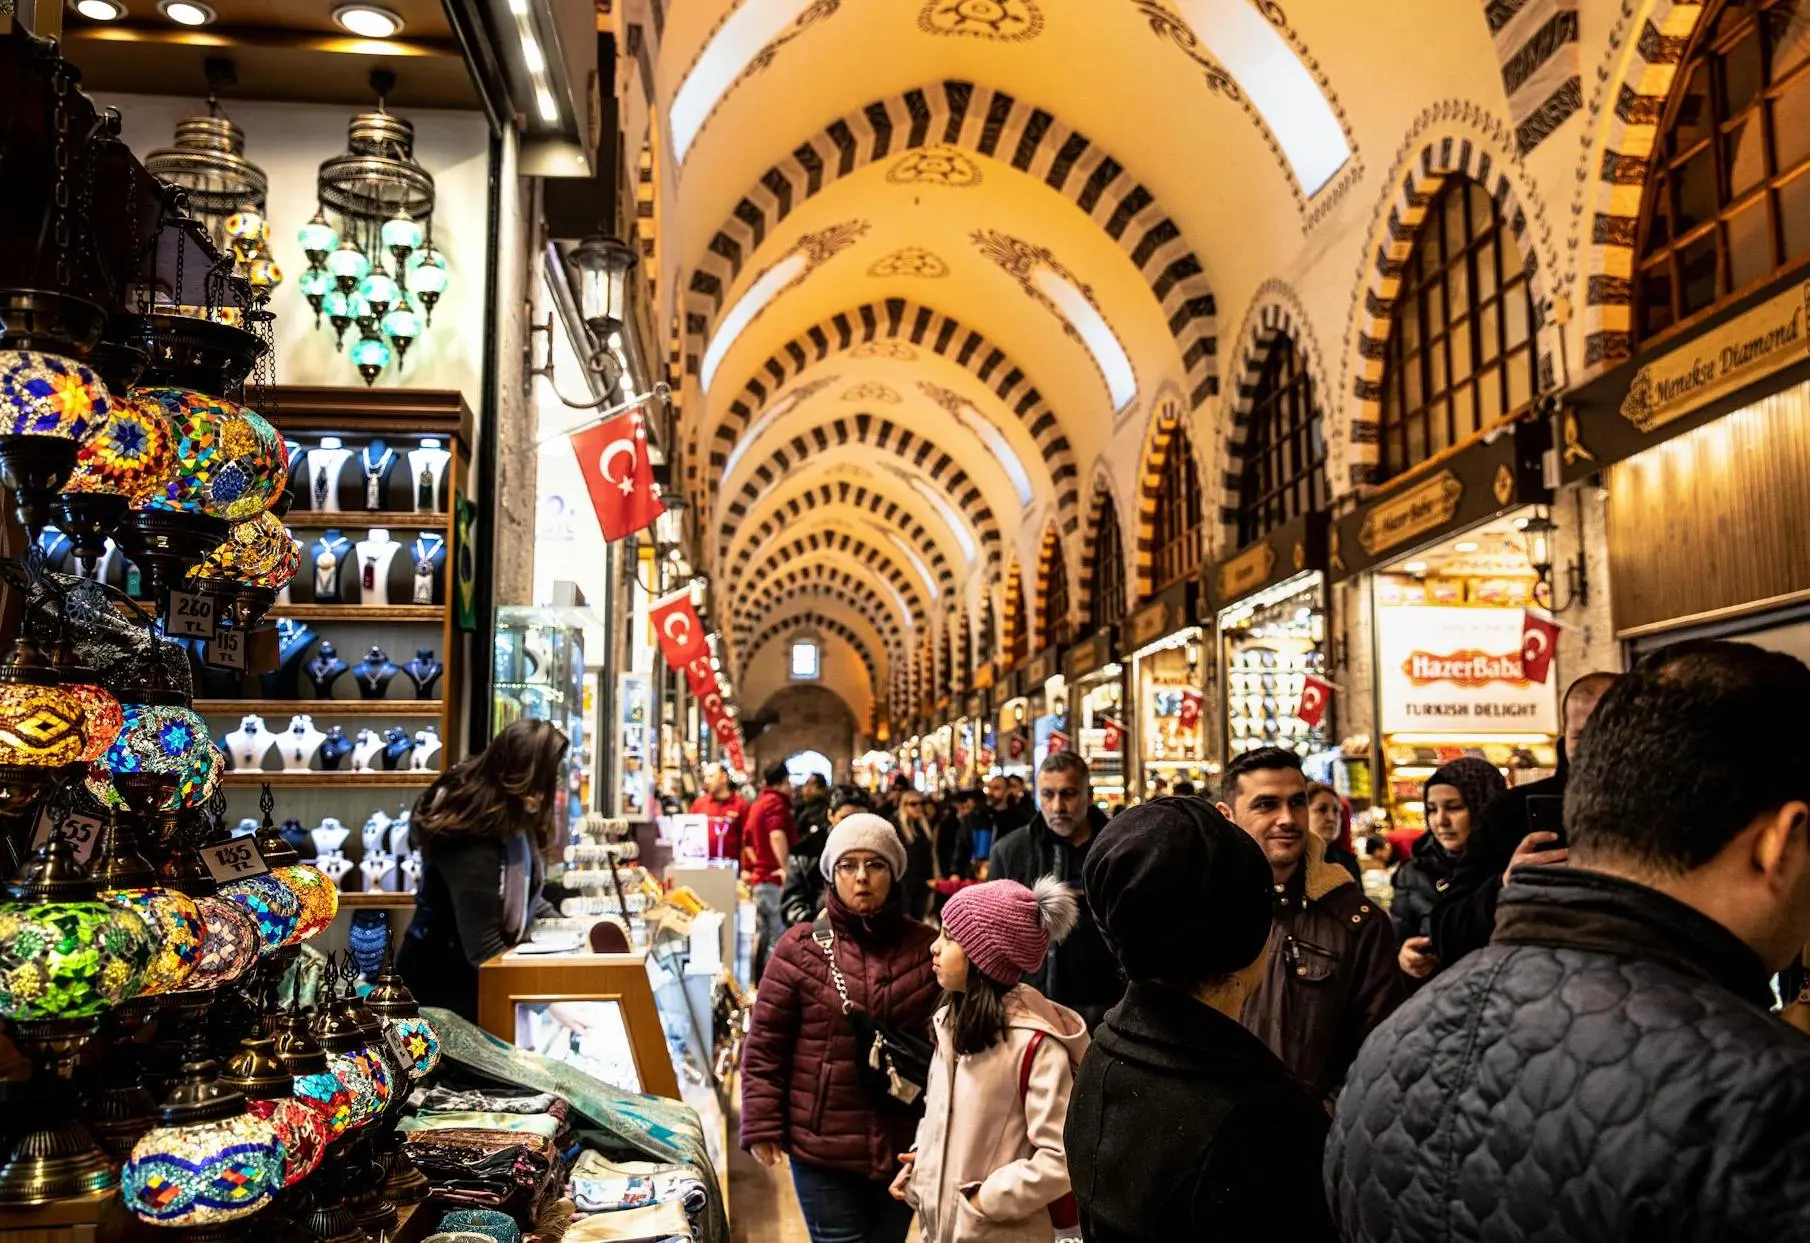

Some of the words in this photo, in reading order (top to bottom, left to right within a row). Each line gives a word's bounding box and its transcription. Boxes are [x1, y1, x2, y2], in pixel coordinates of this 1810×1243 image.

[1719, 306, 1802, 374] Diamond
[177, 598, 211, 618] 260
[184, 621, 206, 633] TL
[217, 632, 238, 651] 115
[218, 652, 235, 662] TL
[1406, 703, 1469, 717] TURKISH
[1474, 703, 1537, 717] DELIGHT
[230, 861, 256, 872] TL
